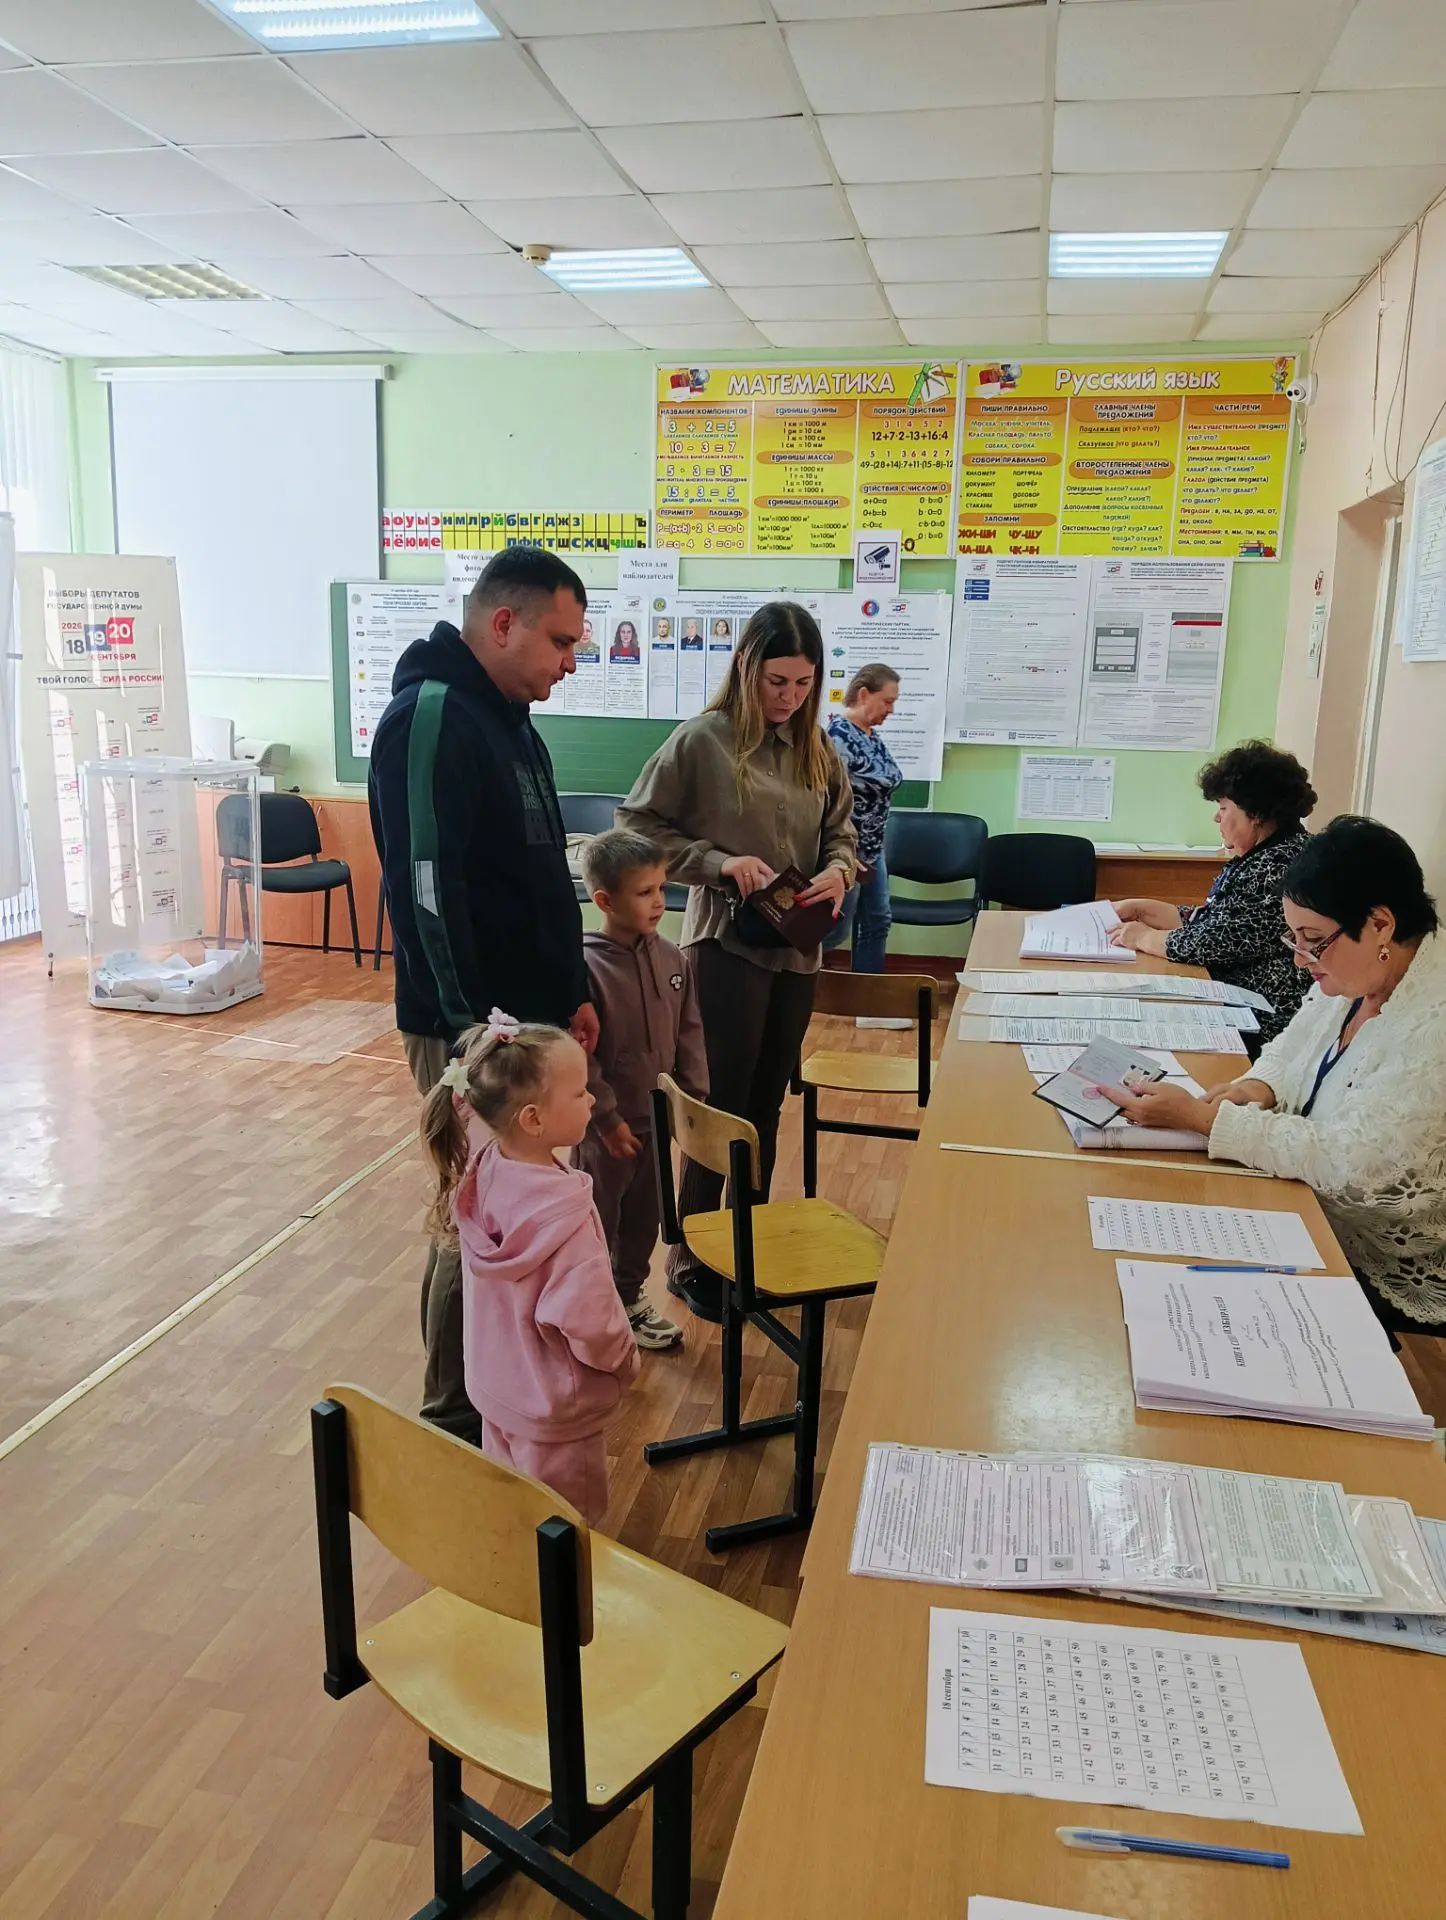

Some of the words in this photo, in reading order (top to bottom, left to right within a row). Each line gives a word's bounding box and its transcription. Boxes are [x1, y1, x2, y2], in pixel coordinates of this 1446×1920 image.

[728, 372, 895, 396] МАТЕМАТИКА
[1055, 368, 1156, 396] Русский
[669, 420, 677, 432] 3
[705, 420, 713, 432] 2
[728, 420, 736, 432] 5
[670, 442, 682, 453] 10
[701, 442, 709, 453] 3
[728, 442, 736, 453] 7
[667, 465, 675, 476] 5
[693, 465, 701, 476] 3
[720, 465, 732, 476] 15
[667, 486, 679, 497] 15
[697, 486, 704, 497] 3
[727, 486, 735, 497] 5
[958, 529, 996, 539] ЖИ-ШИ
[622, 572, 674, 580] наблюдателей
[66, 640, 85, 654] 18
[87, 631, 105, 646] 19
[108, 624, 130, 638] 20
[37, 676, 61, 684] ТВОЙ
[1016, 1636, 1024, 1644] 30
[1071, 1642, 1080, 1650] 50
[1017, 1650, 1025, 1658] 29
[1073, 1656, 1081, 1664] 49
[1018, 1663, 1026, 1671] 28
[1019, 1677, 1027, 1685] 27
[1131, 1676, 1140, 1684] 68
[1076, 1683, 1084, 1692] 47
[1020, 1691, 1028, 1699] 26
[1134, 1690, 1143, 1698] 67
[1020, 1706, 1029, 1714] 25
[1080, 1712, 1088, 1720] 45
[1021, 1721, 1030, 1729] 24
[1139, 1719, 1148, 1728] 65
[1082, 1728, 1089, 1736] 44
[1022, 1736, 1031, 1745] 23
[1023, 1752, 1032, 1760] 22
[1084, 1759, 1093, 1767] 42
[1024, 1767, 1033, 1775] 21
[1146, 1765, 1156, 1774] 62
[1087, 1774, 1095, 1782] 41
